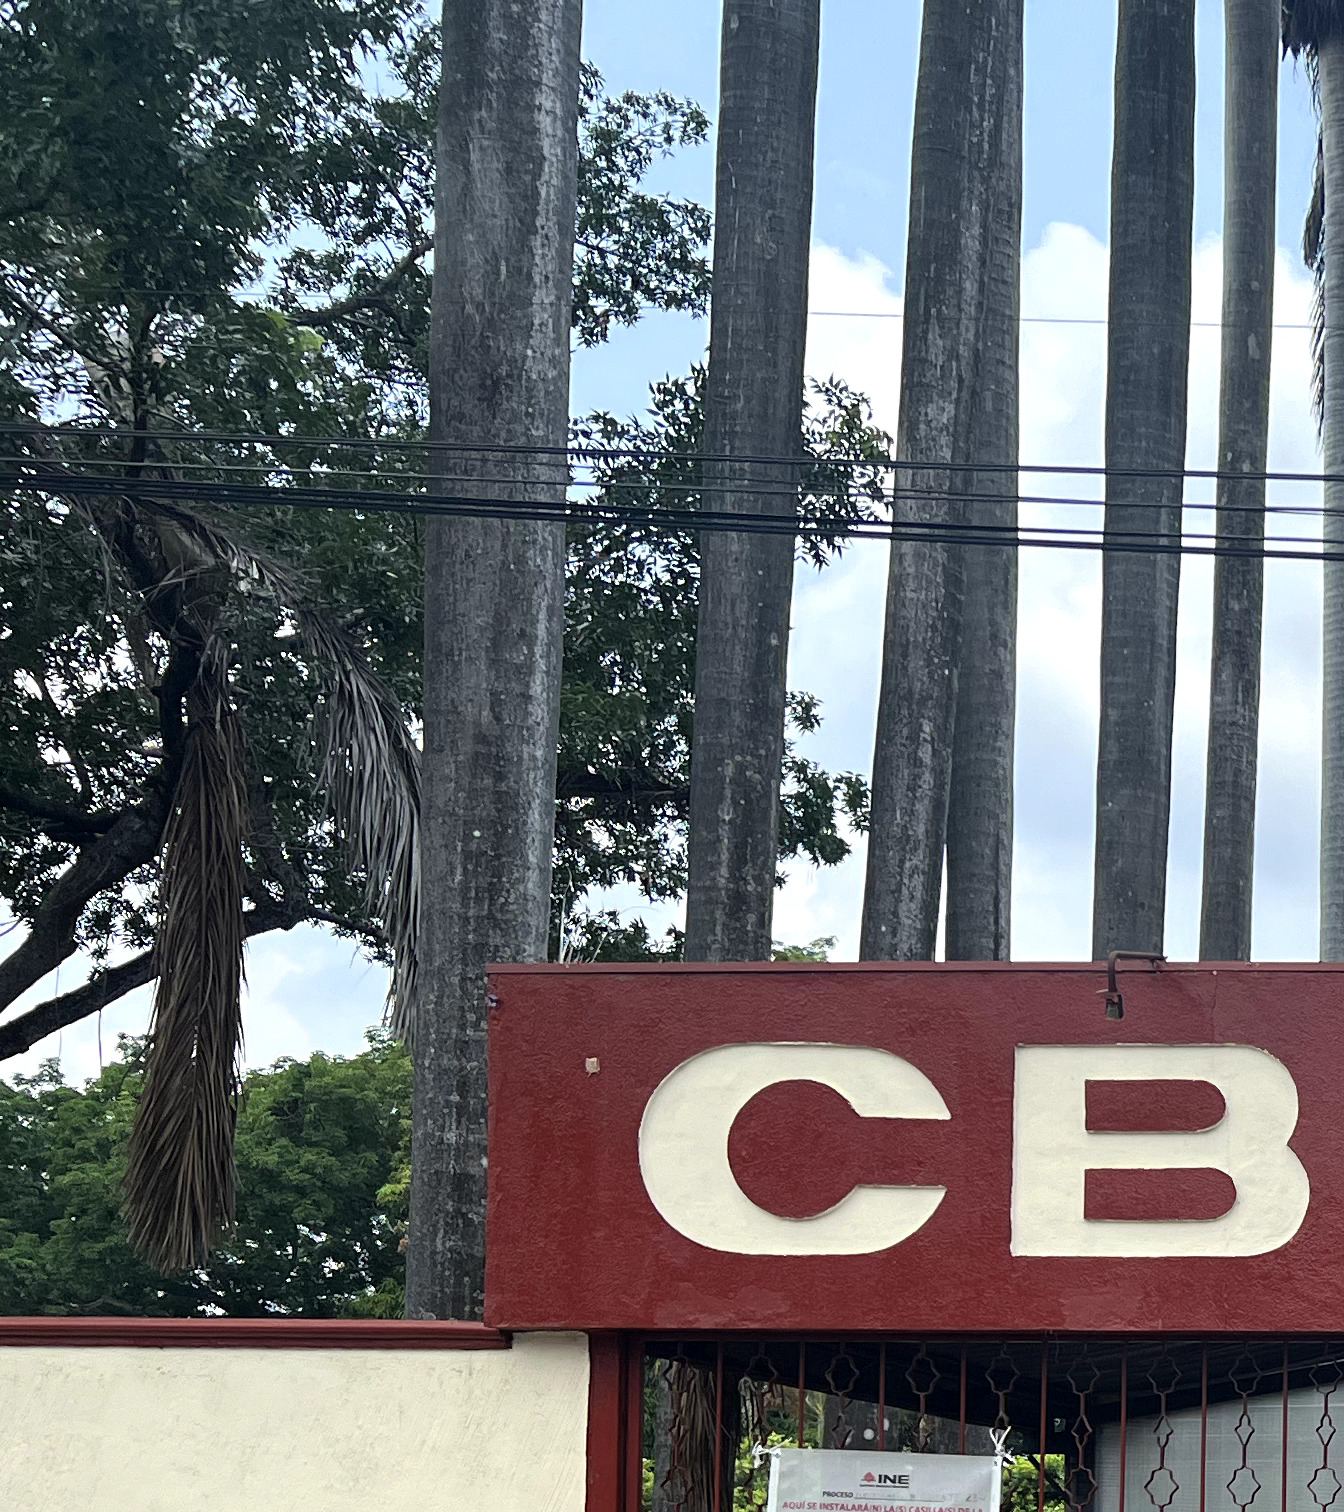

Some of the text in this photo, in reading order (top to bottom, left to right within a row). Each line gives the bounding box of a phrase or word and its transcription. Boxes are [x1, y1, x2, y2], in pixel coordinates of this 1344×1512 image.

[878, 1474, 910, 1486] INE
[822, 1490, 853, 1499] PROCESO
[782, 1500, 805, 1510] AQUÍ
[806, 1502, 817, 1510] SE
[819, 1502, 882, 1512] INSTALARÁ(N)
